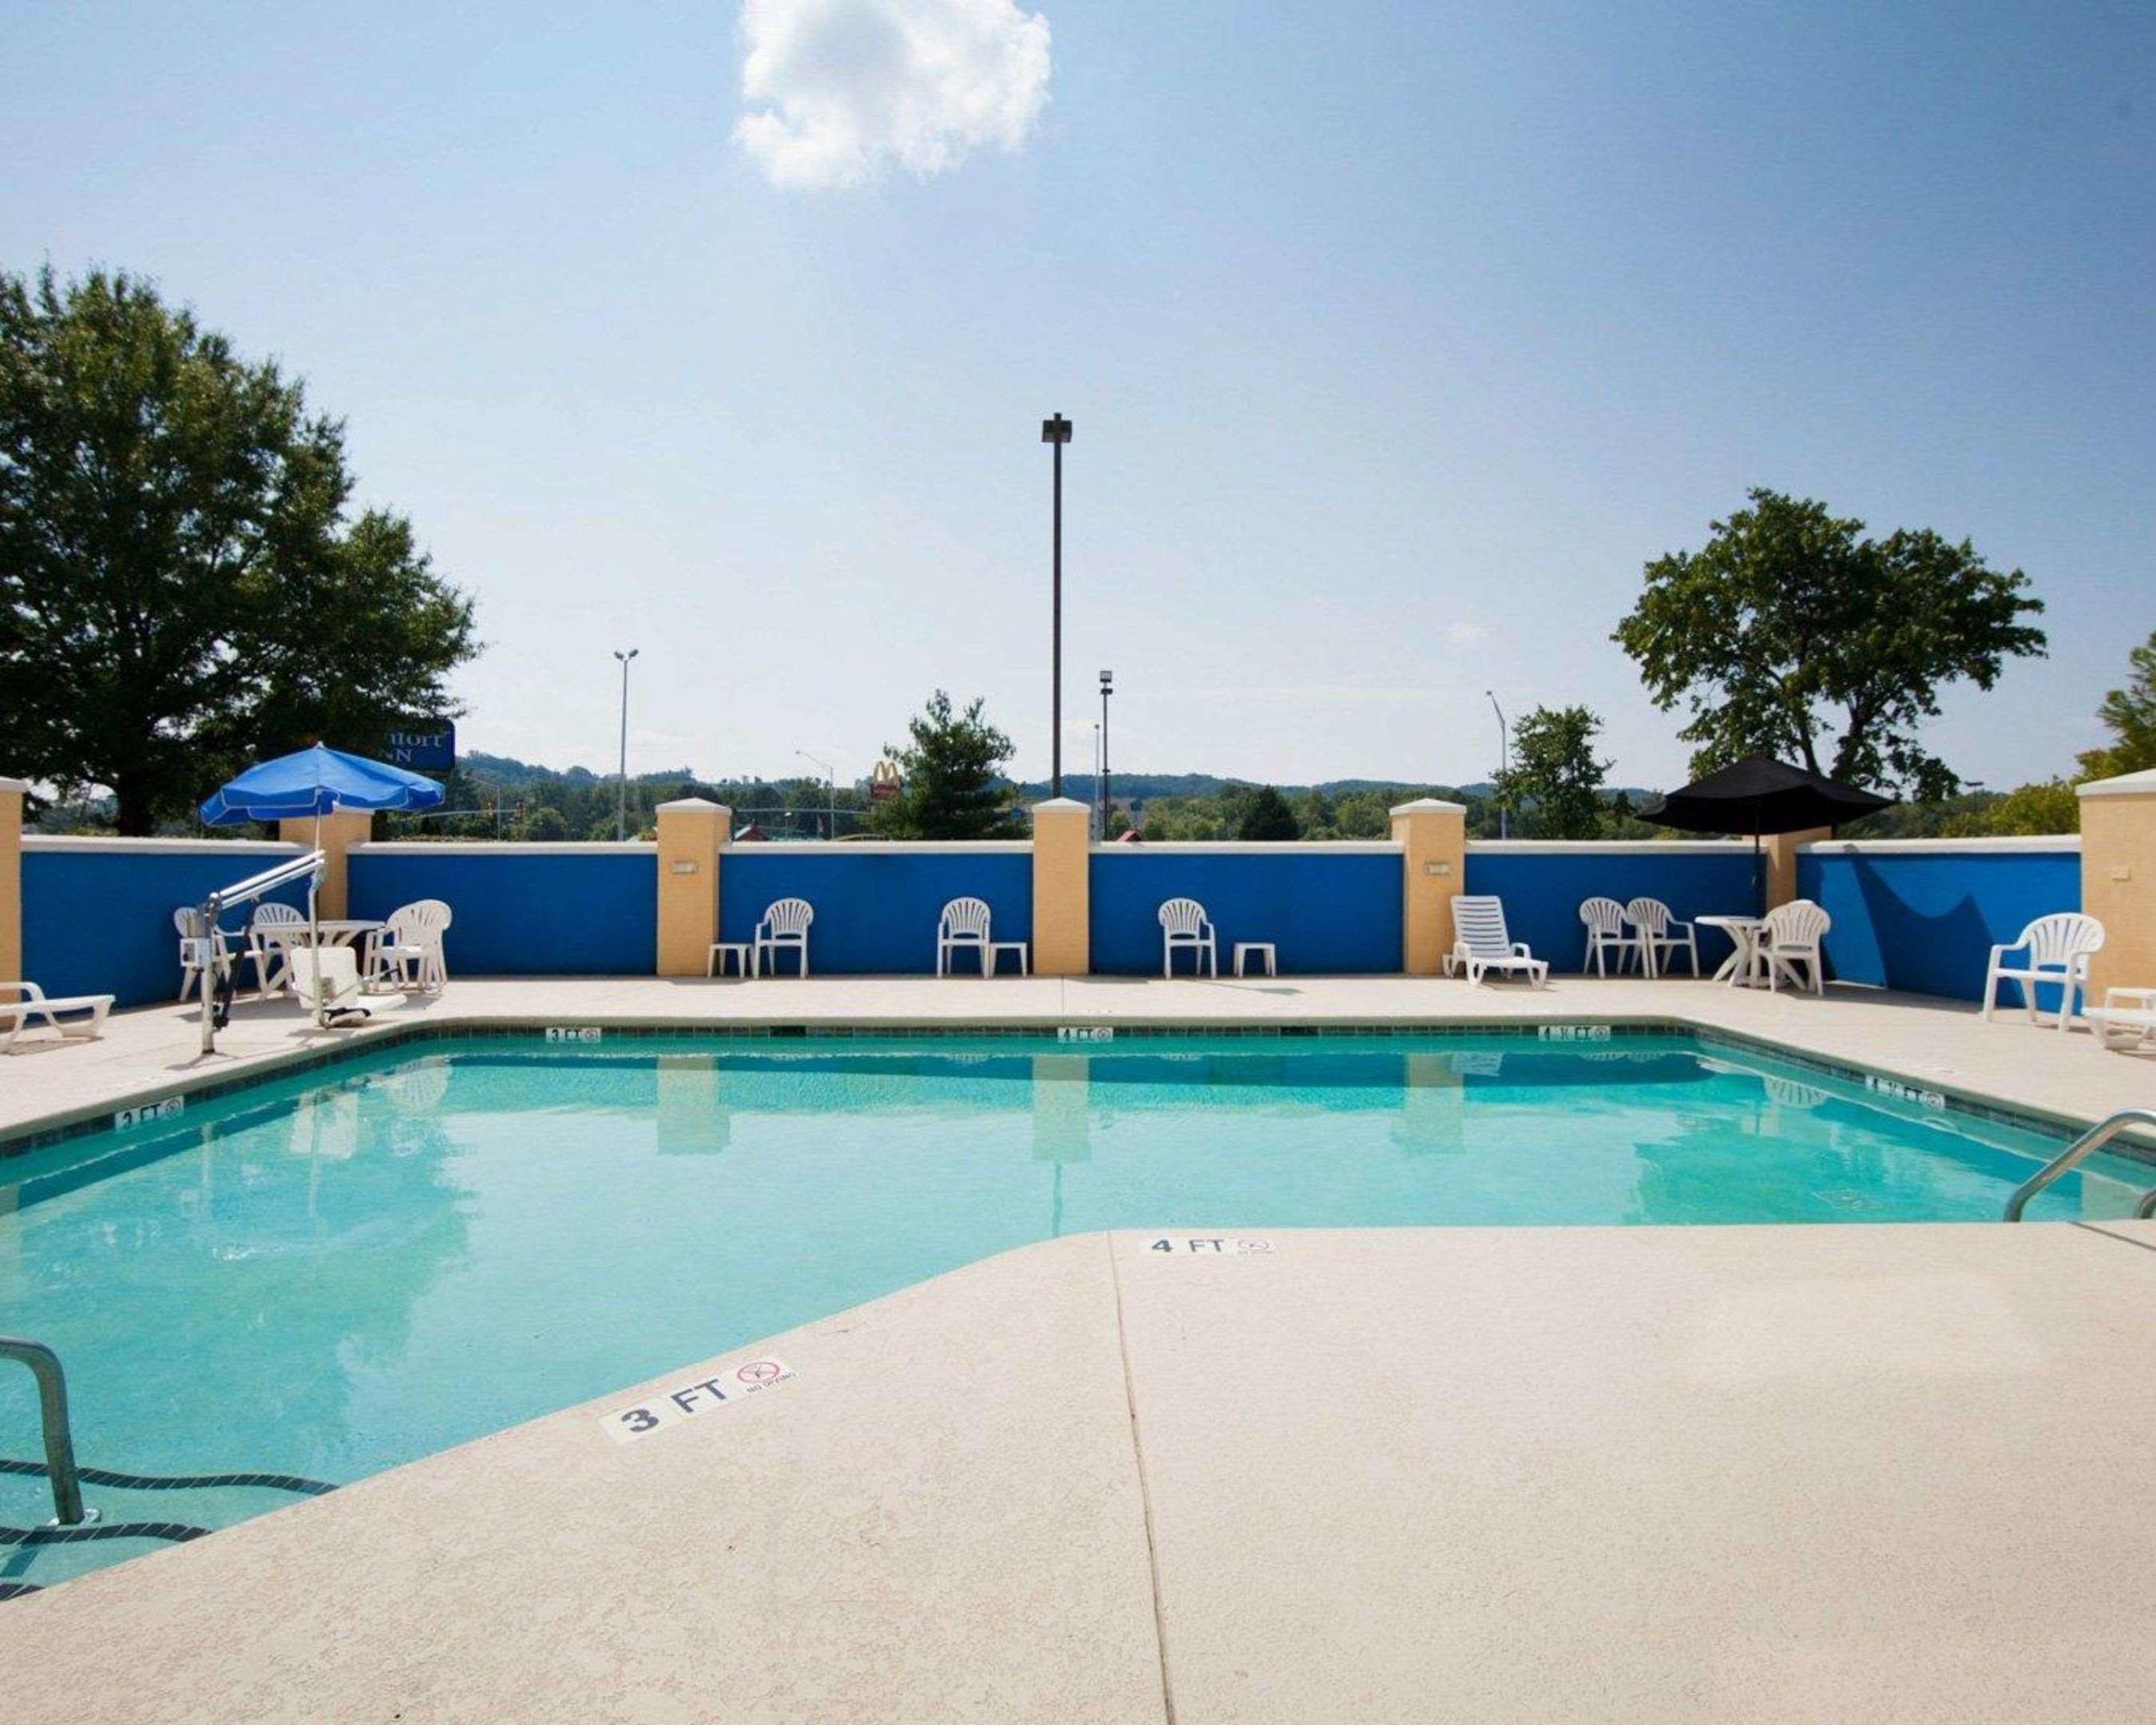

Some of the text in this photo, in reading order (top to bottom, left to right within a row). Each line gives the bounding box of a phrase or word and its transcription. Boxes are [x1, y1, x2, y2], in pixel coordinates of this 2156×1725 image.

[1151, 1239, 1224, 1252] 4 FT
[620, 1378, 727, 1433] 3 FT
